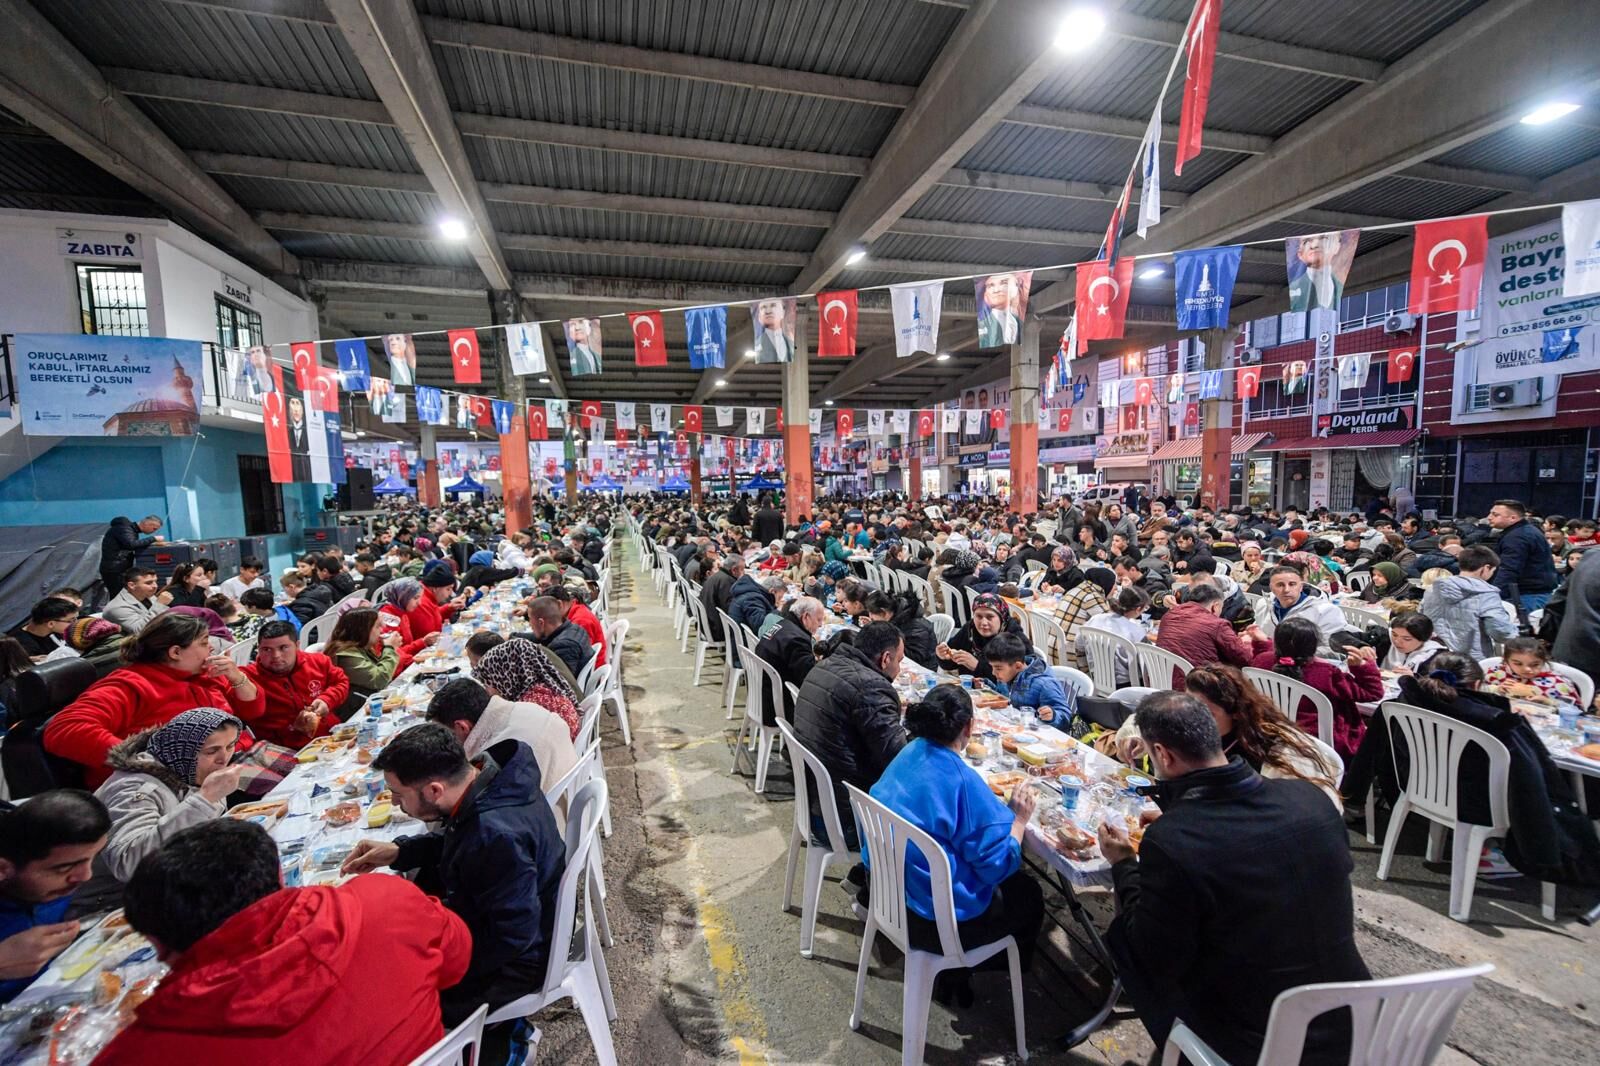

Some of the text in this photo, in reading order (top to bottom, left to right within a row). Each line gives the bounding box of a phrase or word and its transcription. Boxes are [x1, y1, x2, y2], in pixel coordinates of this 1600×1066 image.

[67, 242, 134, 257] ZABITA
[27, 351, 108, 362] ORUÇLARIMIZ
[29, 361, 151, 374] KABUL, İFTARLARIMIZ
[30, 373, 133, 384] BEREKETLİ OLSUN
[1332, 407, 1399, 428] Devland
[1350, 425, 1378, 434] PERDE
